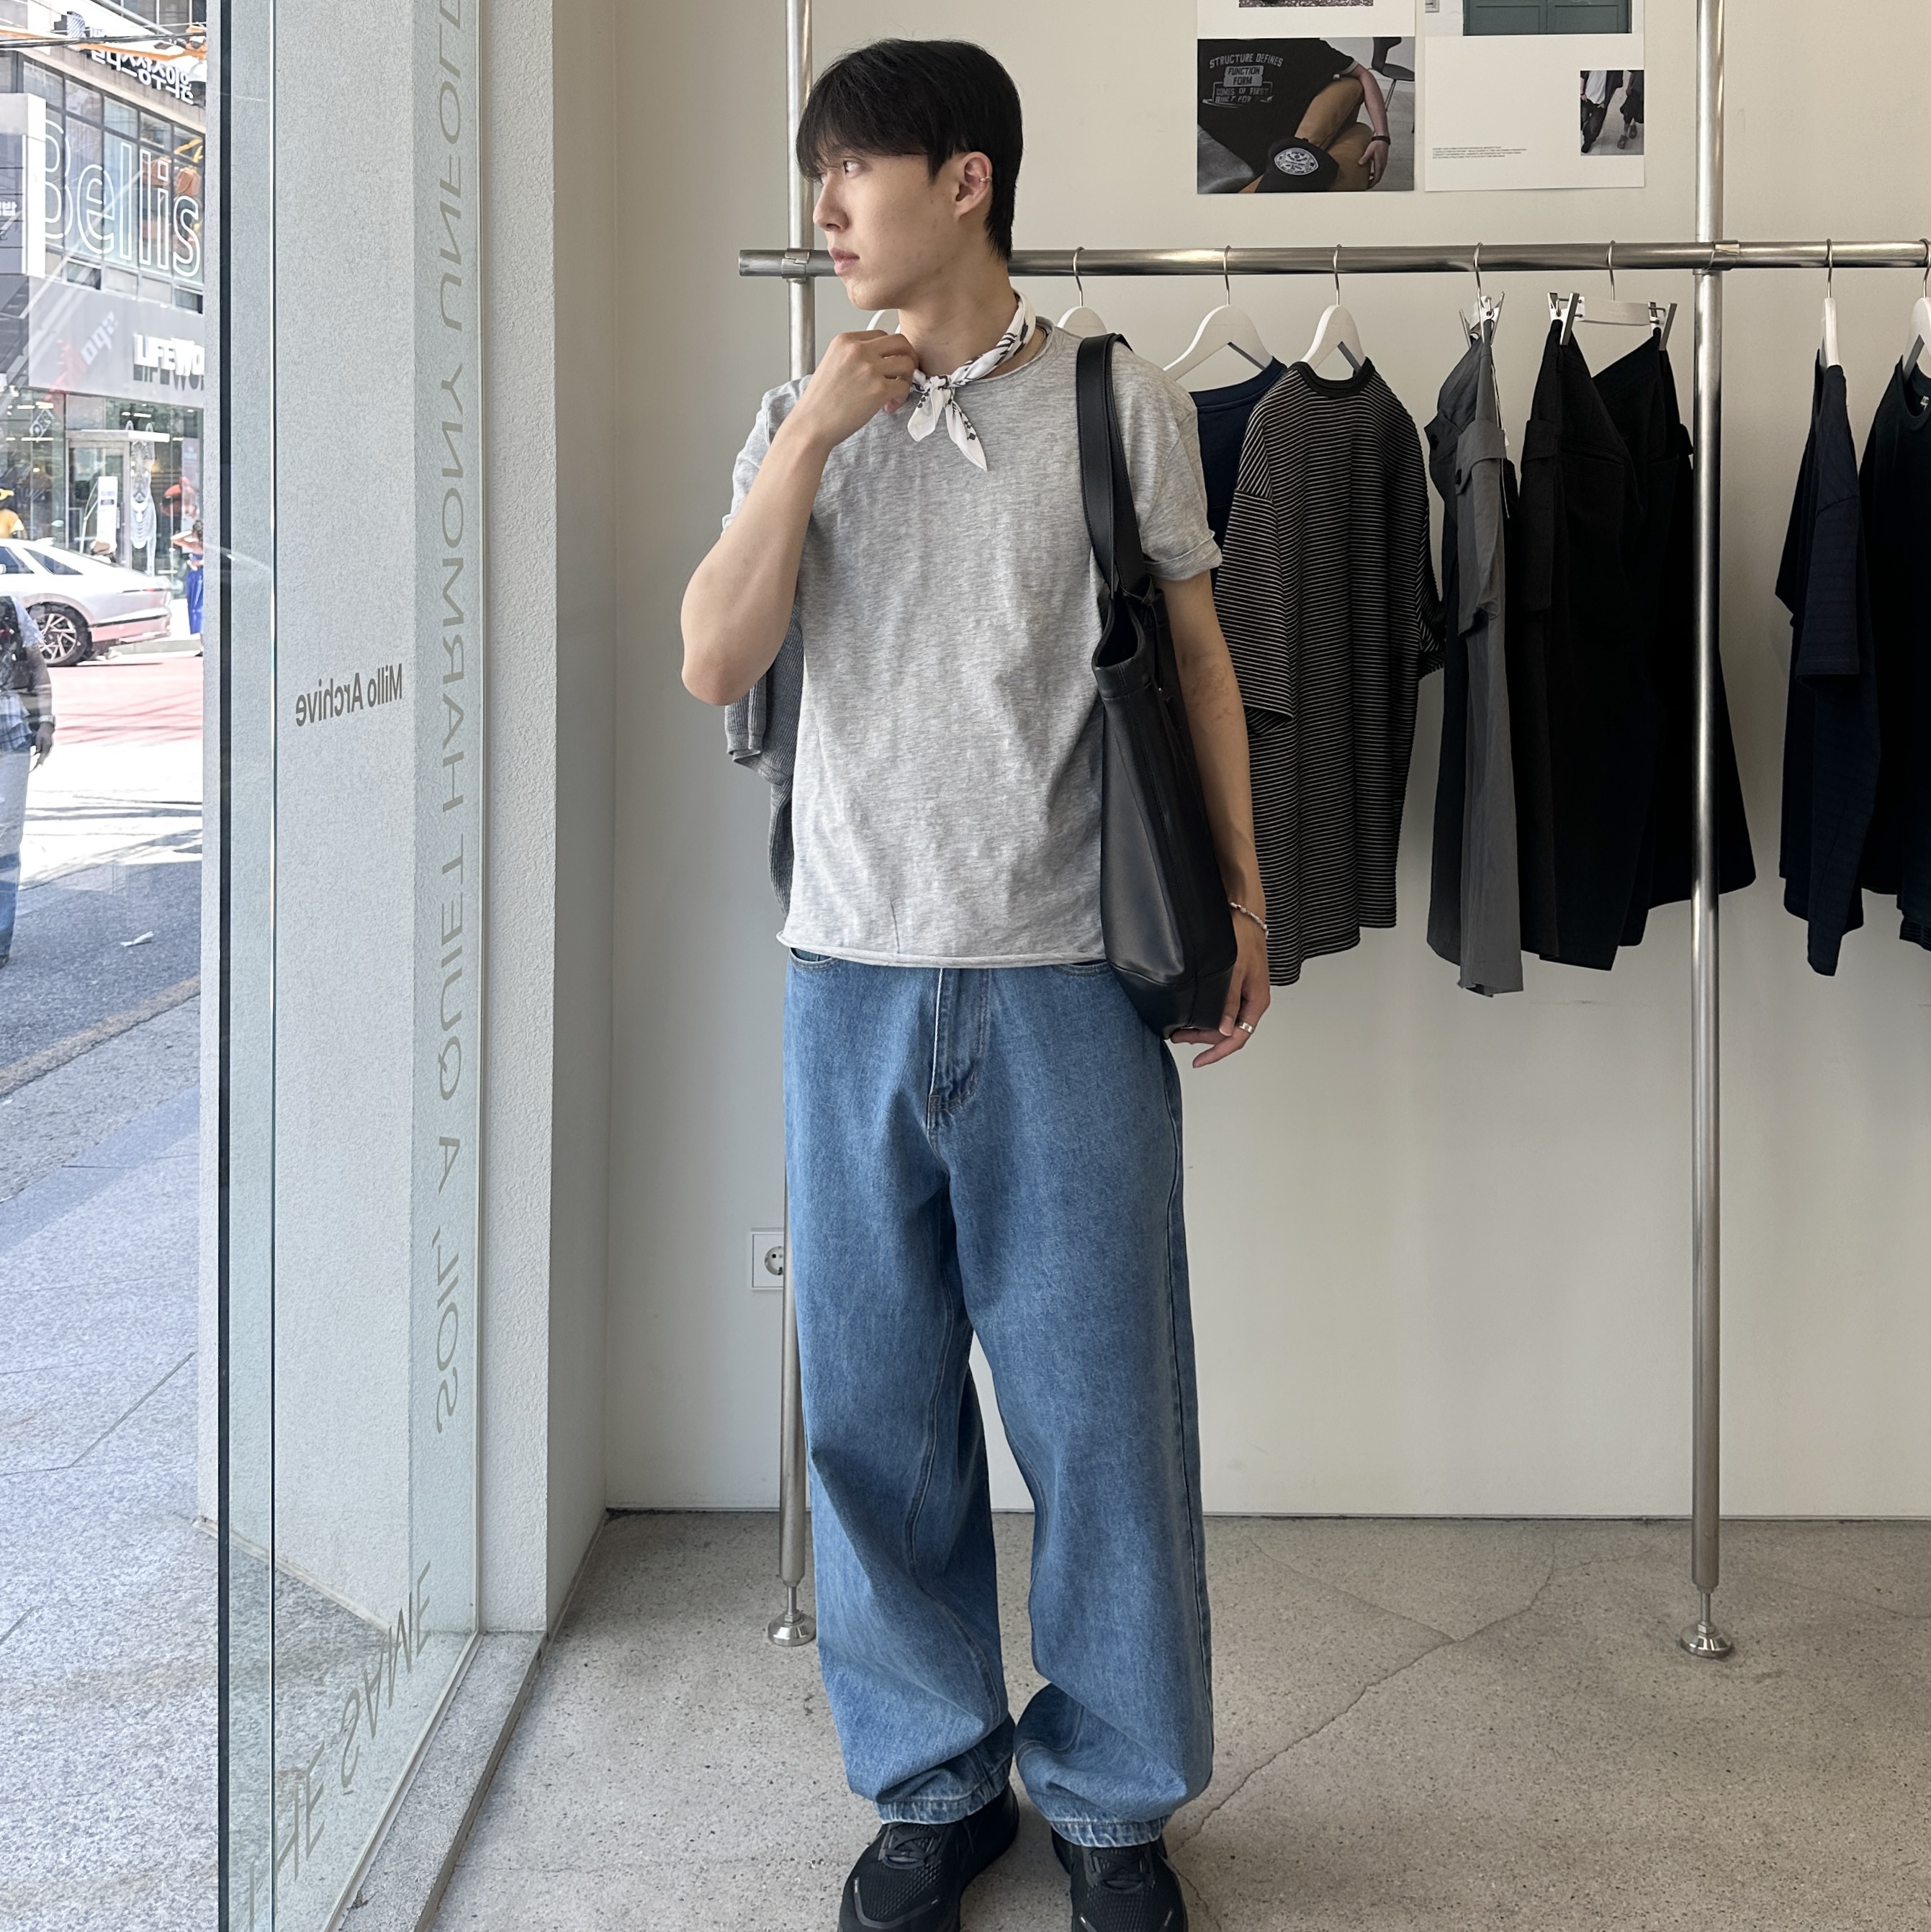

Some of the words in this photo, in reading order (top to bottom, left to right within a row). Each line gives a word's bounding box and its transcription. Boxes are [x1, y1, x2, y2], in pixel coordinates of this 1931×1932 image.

[1210, 53, 1254, 69] STRUCTURE
[1256, 53, 1284, 68] DEFINES
[1228, 66, 1261, 76] FUNCTION
[1233, 76, 1253, 85] FORM
[45, 119, 201, 277] Bellis
